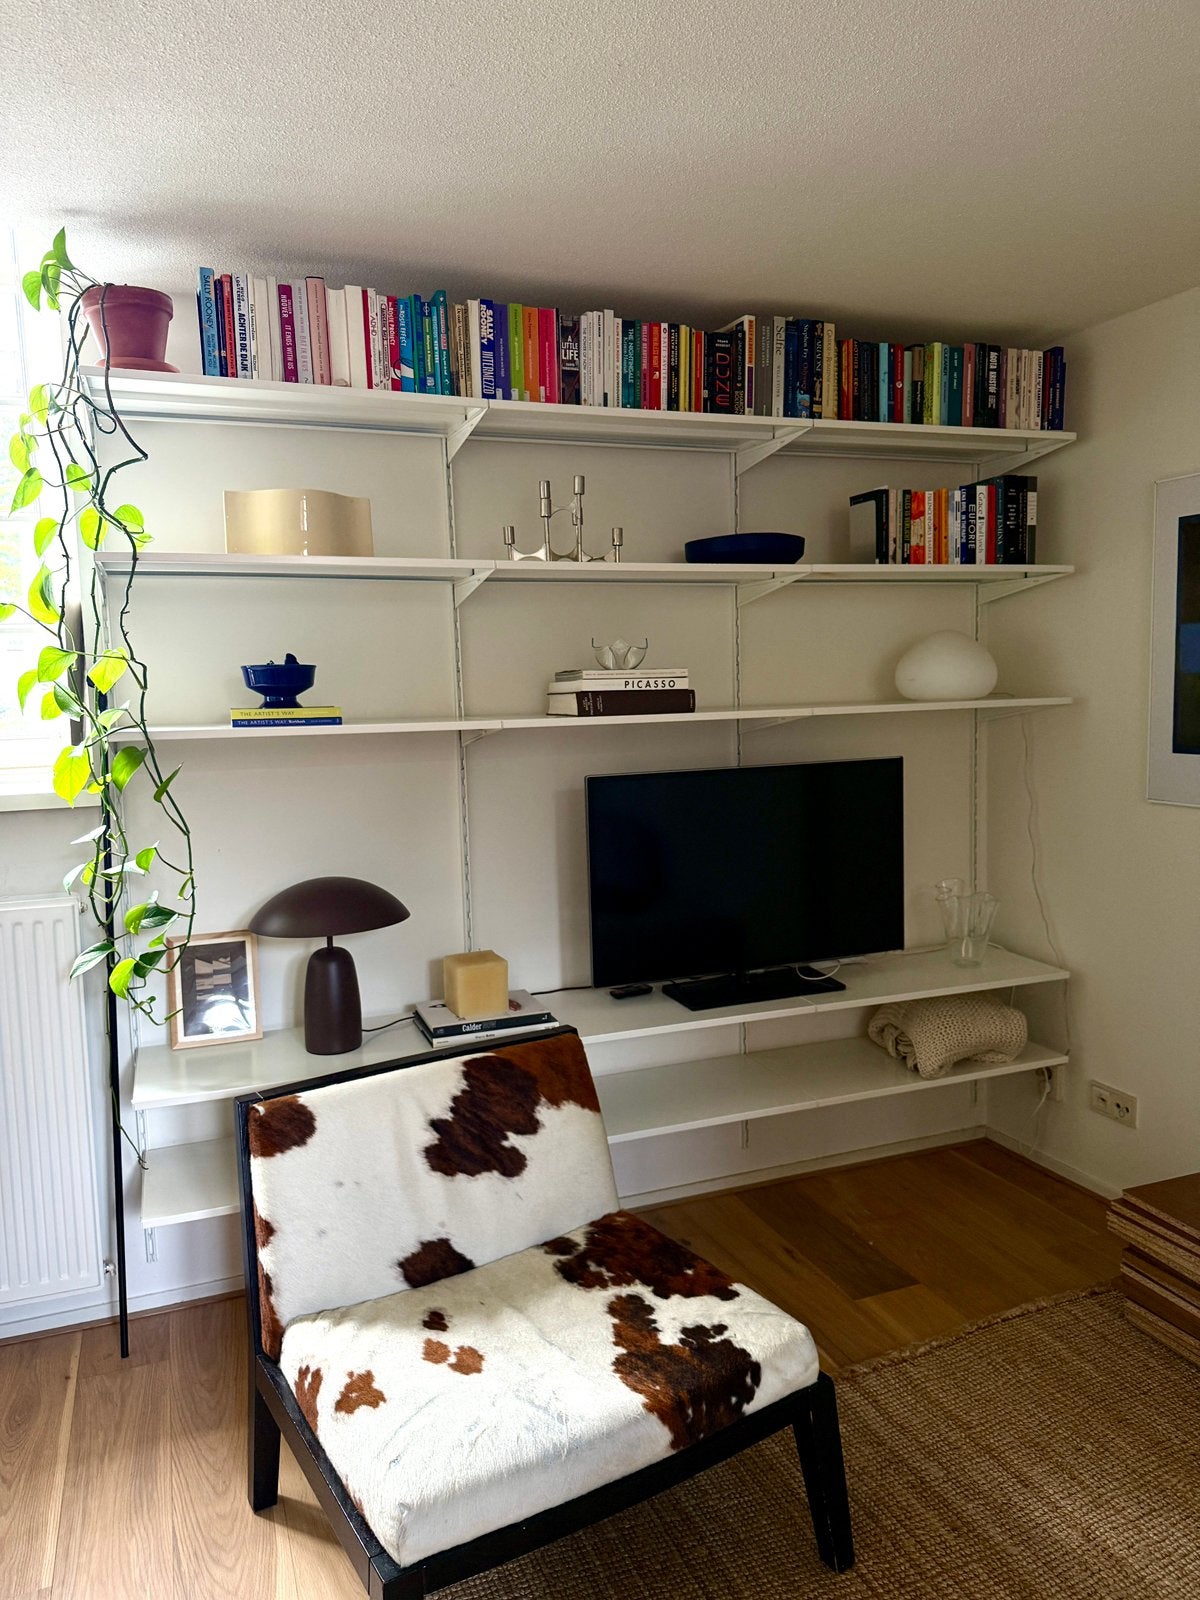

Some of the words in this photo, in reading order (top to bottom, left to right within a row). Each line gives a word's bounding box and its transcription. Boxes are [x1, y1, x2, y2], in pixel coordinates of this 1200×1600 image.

[203, 275, 211, 294] SALLY
[205, 297, 213, 328] ROONEY
[238, 313, 247, 341] ACHTER
[240, 342, 247, 352] DE
[562, 342, 578, 350] LITTLE
[776, 326, 784, 355] Selfie
[562, 350, 578, 360] LIFE
[482, 351, 494, 394] INTERMEZZO
[624, 680, 676, 688] PICASSO
[462, 1023, 482, 1032] Calder
